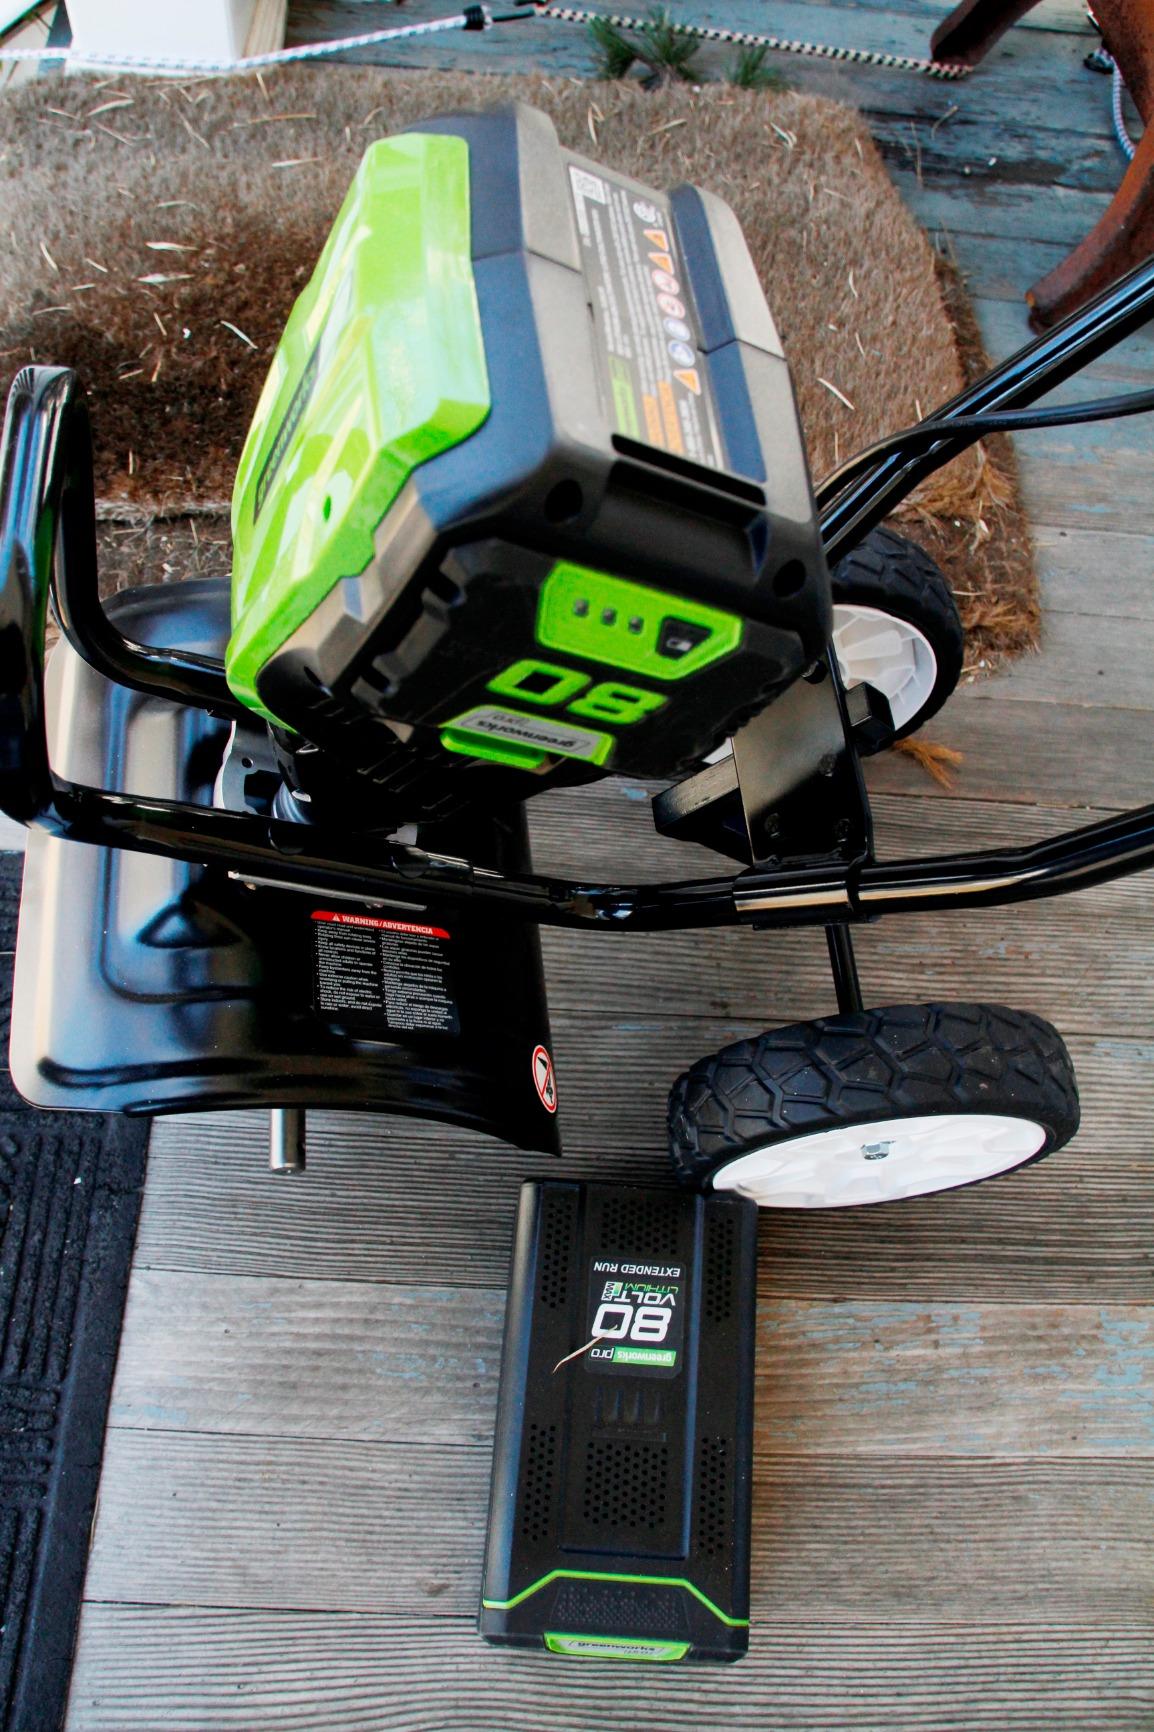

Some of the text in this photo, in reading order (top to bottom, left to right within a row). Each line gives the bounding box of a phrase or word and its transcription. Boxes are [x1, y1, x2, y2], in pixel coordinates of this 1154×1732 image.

[486, 659, 667, 724] 80
[477, 719, 576, 748] greenworks
[342, 915, 379, 927] WARNING
[383, 921, 433, 934] ADVERTENCIA
[593, 1261, 681, 1278] EXTENDED RUN
[602, 1281, 614, 1301] MAX
[624, 1282, 679, 1294] LITHIUM
[614, 1290, 676, 1306] VOLT
[591, 1303, 672, 1342] 80
[590, 1348, 673, 1361] greenworks pro
